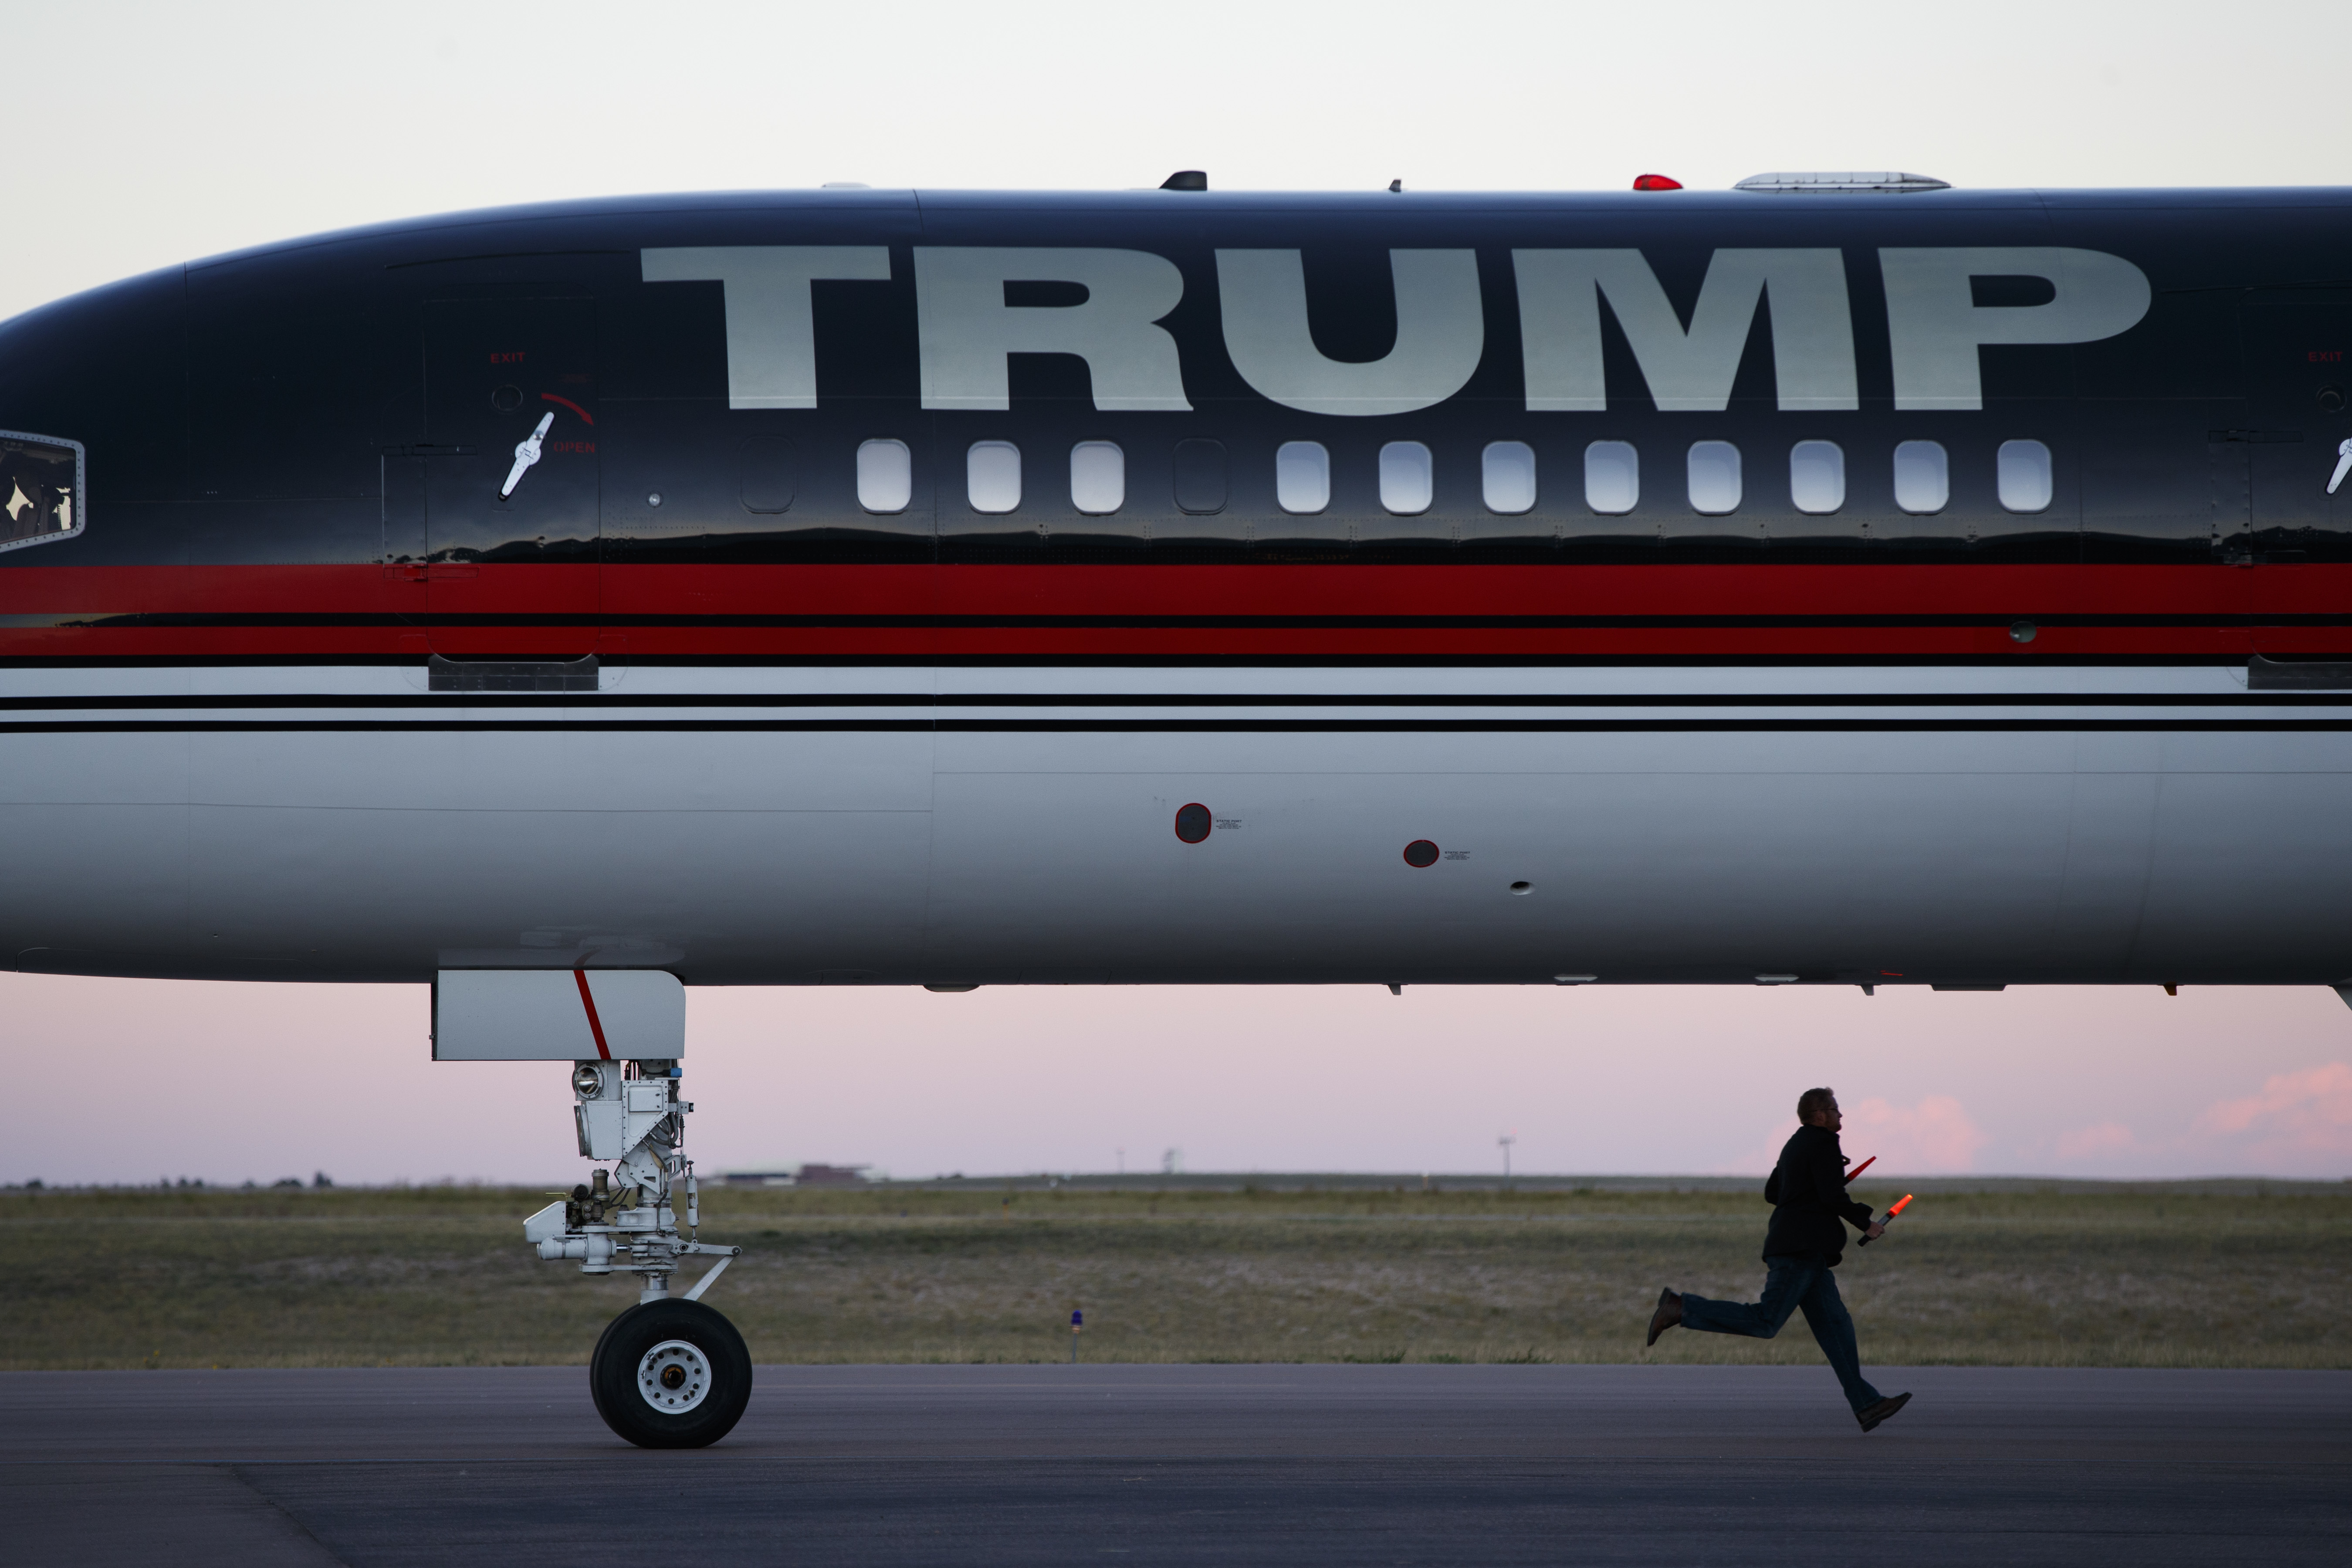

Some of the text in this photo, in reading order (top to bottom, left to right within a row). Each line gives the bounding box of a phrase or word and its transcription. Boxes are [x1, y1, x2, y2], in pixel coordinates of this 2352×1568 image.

[641, 246, 2151, 417] TRUMP
[491, 352, 525, 363] EXIT
[2308, 352, 2343, 362] EXIT
[553, 442, 596, 453] OPEN
